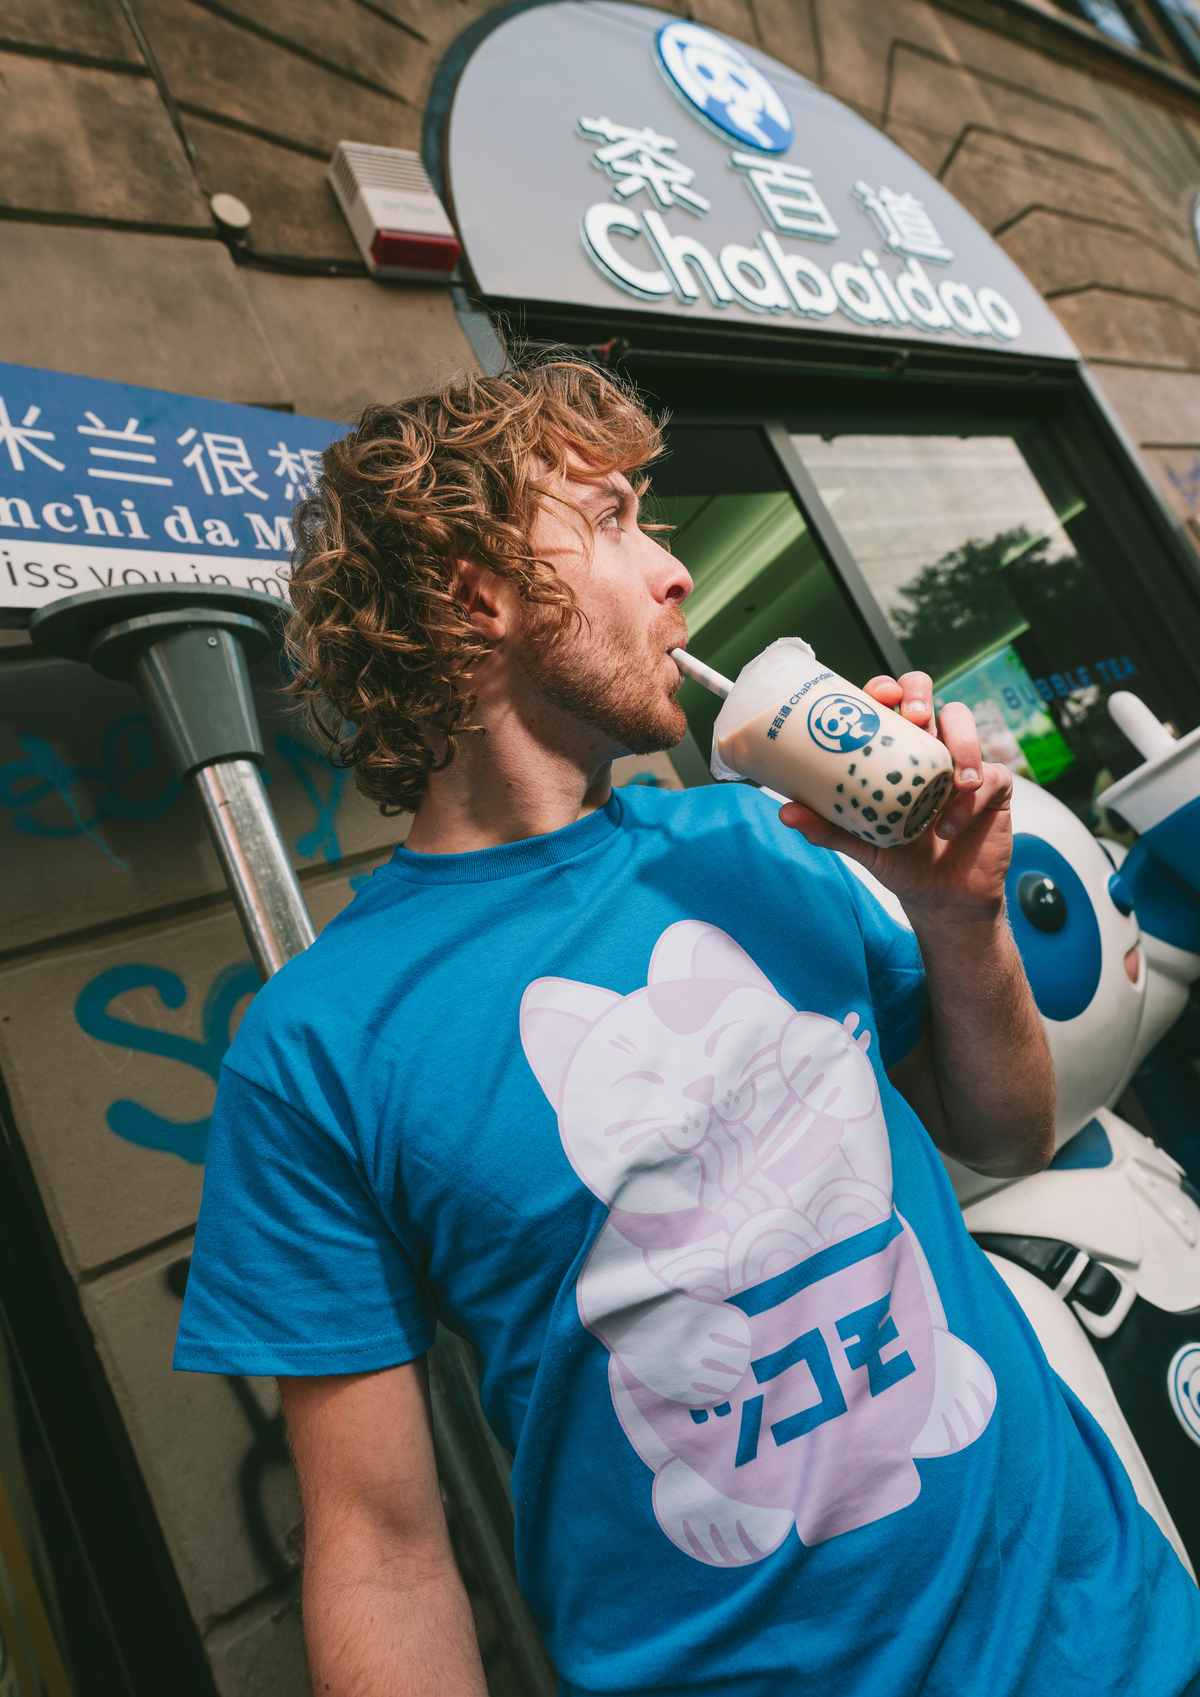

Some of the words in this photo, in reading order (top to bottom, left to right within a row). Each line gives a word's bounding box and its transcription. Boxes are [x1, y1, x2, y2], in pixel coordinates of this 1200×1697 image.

[576, 115, 956, 266] 茶百道
[580, 202, 1022, 342] Chabaidao
[163, 505, 240, 548] da
[1001, 666, 1099, 711] BUBBLE
[1094, 656, 1140, 684] TEA
[766, 704, 793, 741] 茶百道
